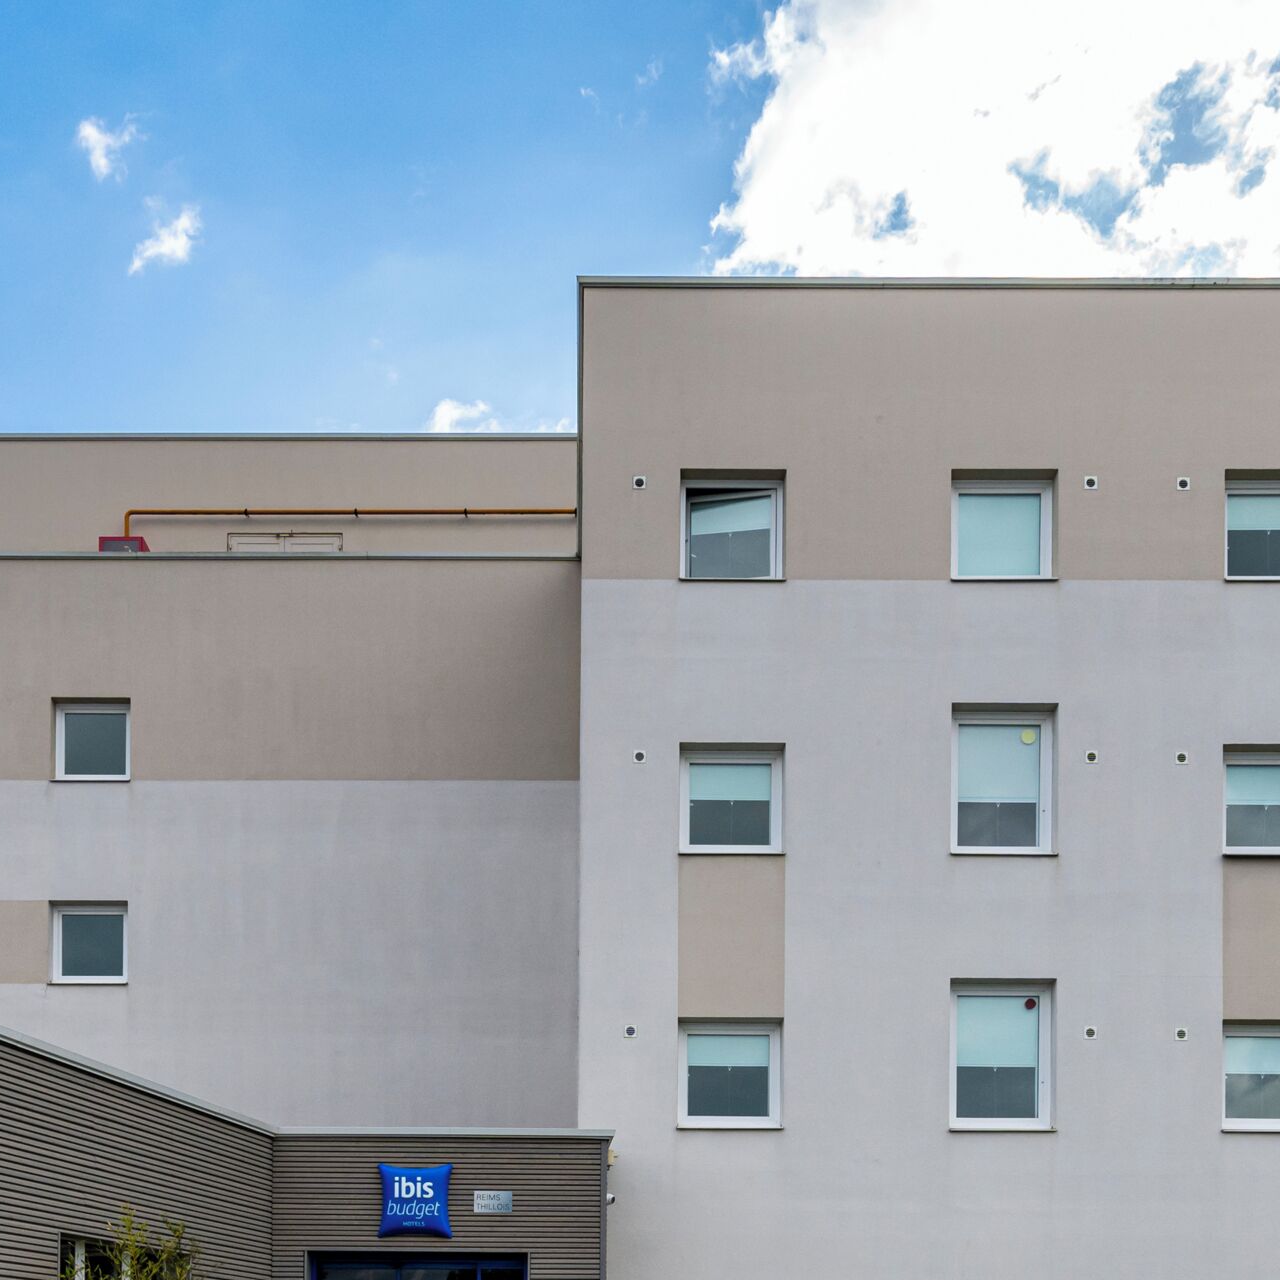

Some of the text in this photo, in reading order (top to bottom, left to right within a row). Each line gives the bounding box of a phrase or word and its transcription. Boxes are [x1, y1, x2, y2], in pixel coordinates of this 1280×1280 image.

[394, 1176, 434, 1198] ibis
[387, 1200, 440, 1219] budget
[476, 1203, 510, 1211] THILLOIS
